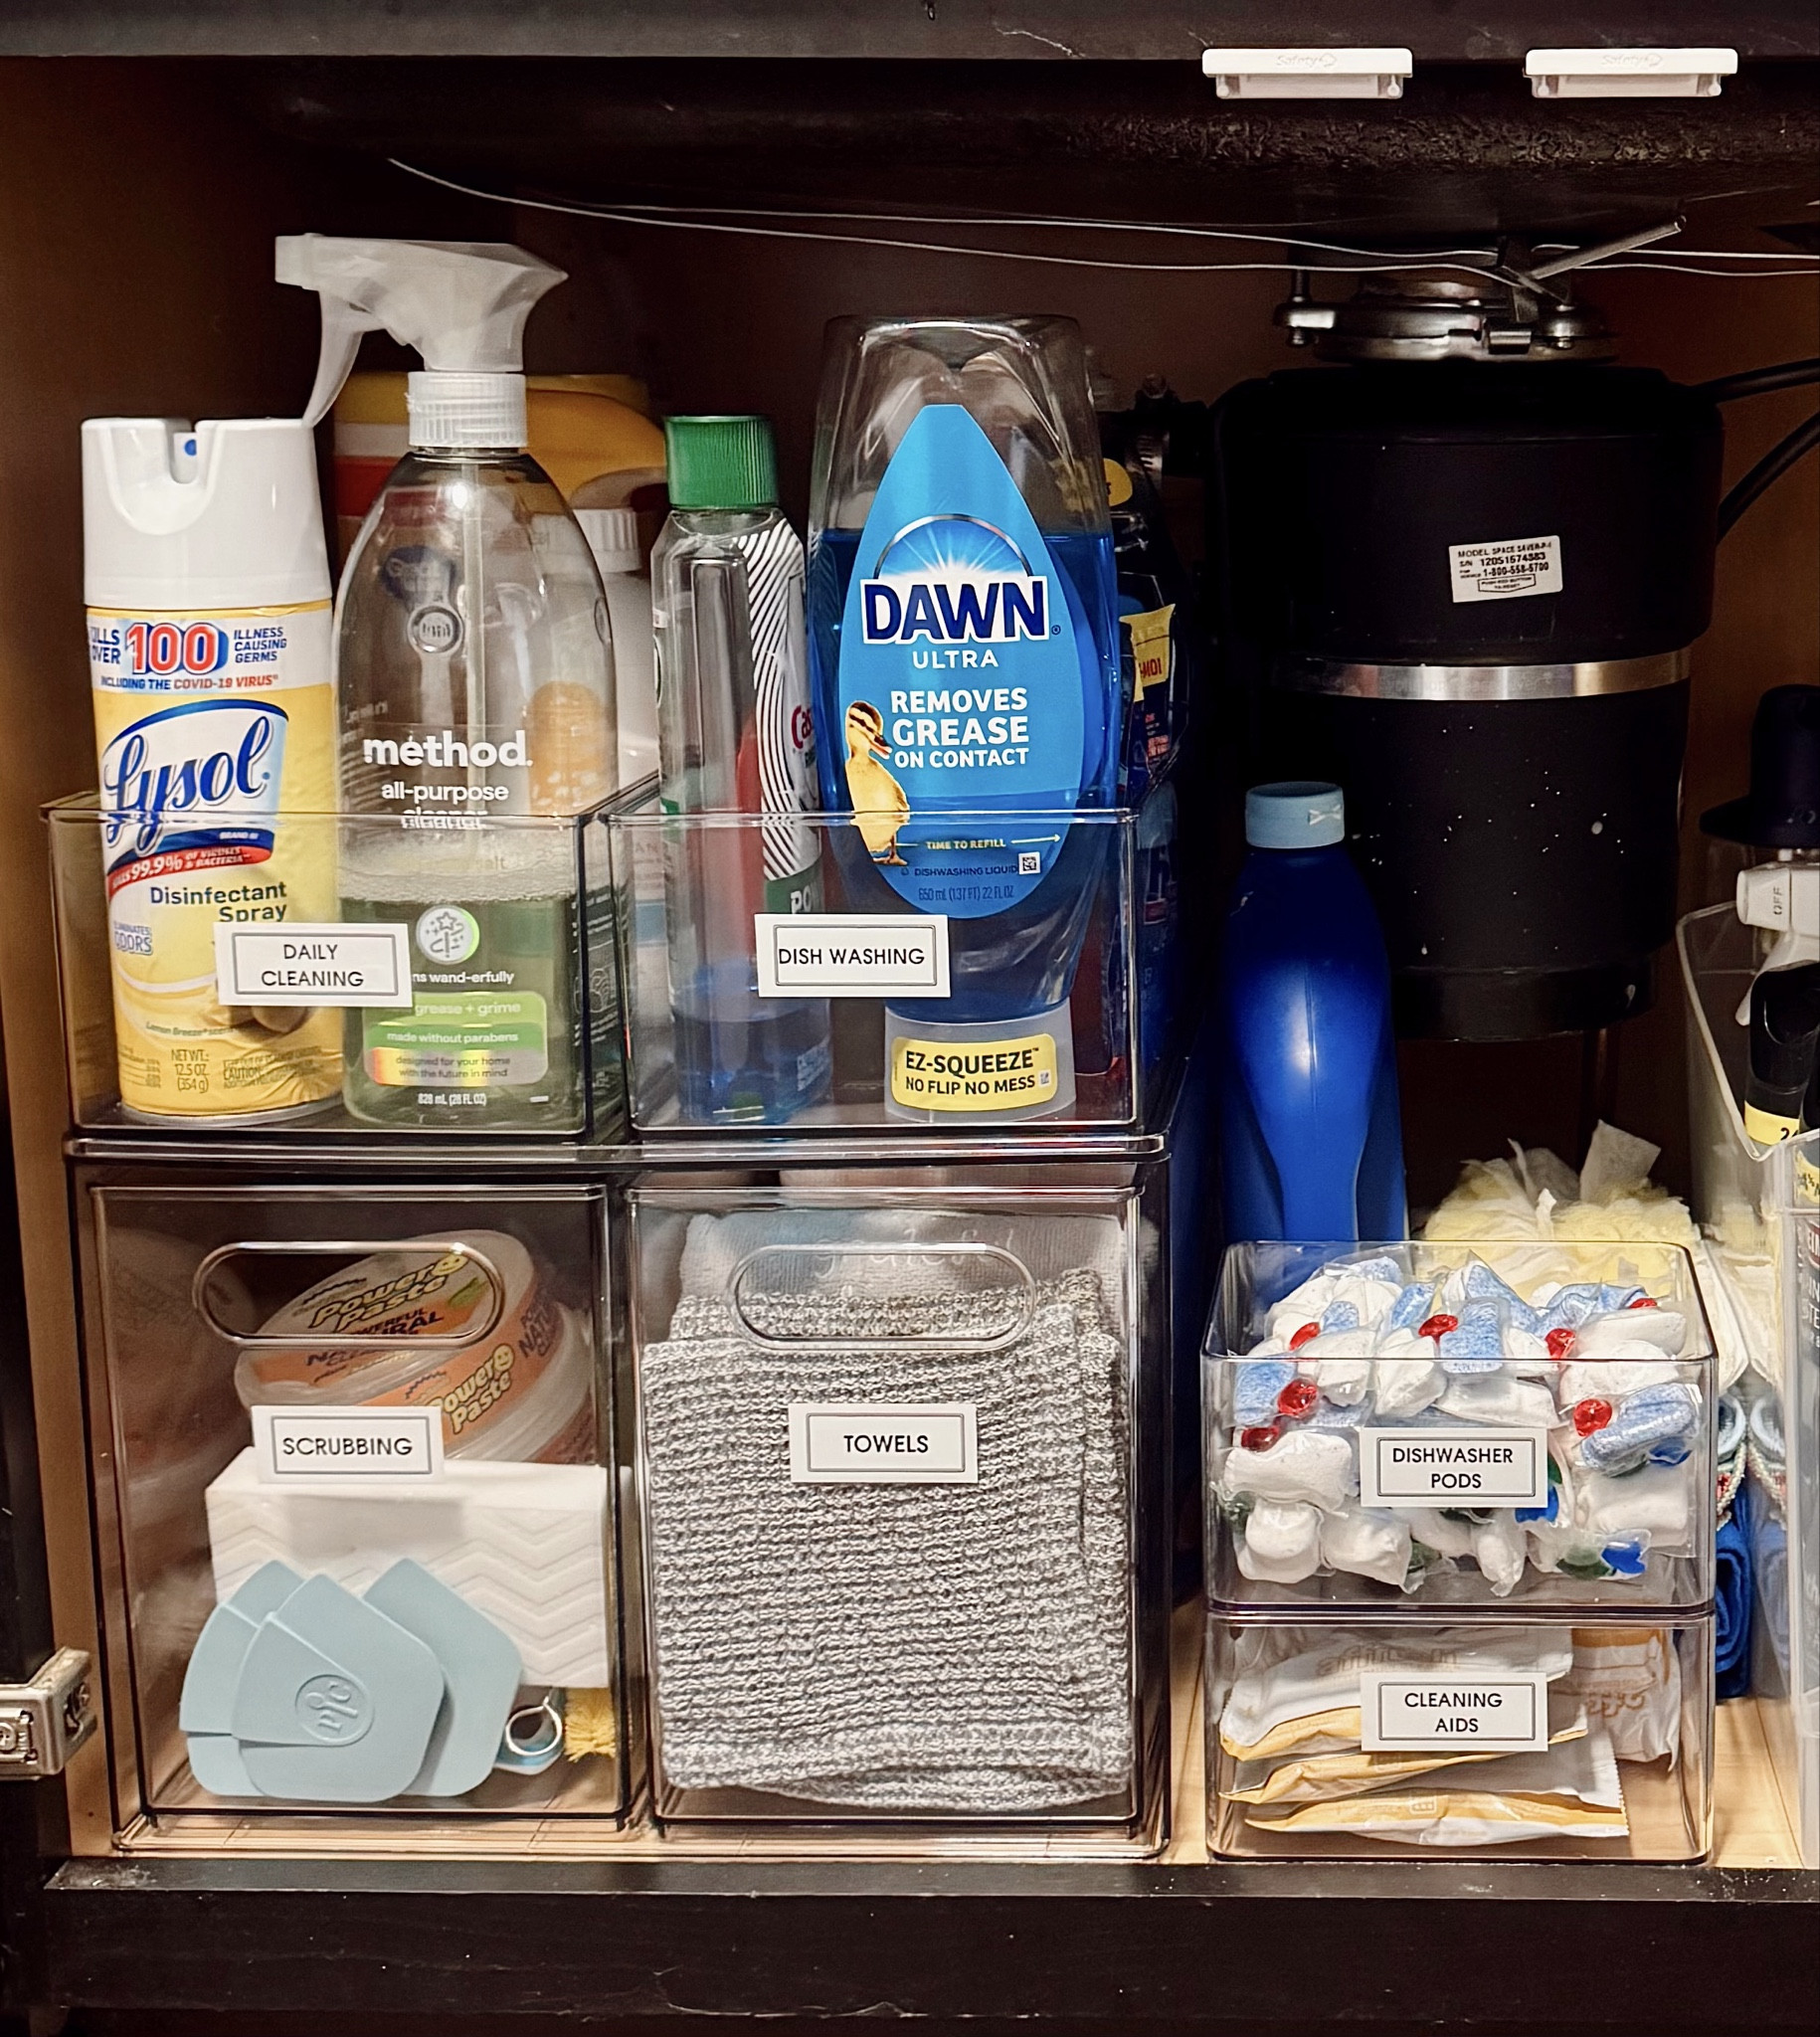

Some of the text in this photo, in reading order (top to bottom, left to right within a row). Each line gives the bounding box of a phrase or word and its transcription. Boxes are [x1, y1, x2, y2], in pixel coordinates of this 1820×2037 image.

[862, 580, 1047, 643] DAWN
[234, 627, 283, 641] ILLNESS
[125, 623, 230, 675] 100
[234, 638, 287, 652] CAUSING
[235, 650, 277, 663] GERMS
[912, 649, 999, 669] ULTRA
[148, 678, 171, 690] THE
[173, 675, 233, 689] COVID-19
[890, 687, 1028, 714] REMOVES
[892, 716, 1030, 747] GREASE
[894, 747, 1030, 769] ON CONTACT
[103, 715, 271, 855] Lysol
[381, 781, 510, 806] all-purpose
[926, 838, 1006, 849] TIME TO REFILL
[129, 854, 183, 881] 99.9%
[914, 864, 1018, 877] DISHWASHING LIQUID
[149, 880, 288, 906] Disinfectant
[982, 887, 993, 899] 22
[1773, 886, 1783, 915] OFF
[218, 903, 288, 924] Spray
[283, 945, 338, 960] DAILY
[779, 948, 925, 965] DISH WASHING
[261, 971, 365, 987] CLEANING
[429, 970, 515, 985] wand-erfully
[414, 1004, 462, 1017] grease
[476, 1002, 521, 1017] grime
[386, 1031, 519, 1044] made without parabens
[438, 1068, 468, 1079] future
[482, 1067, 508, 1077] mind
[905, 1075, 1035, 1095] NO FLIP NO MESS
[451, 1371, 512, 1434] Paste
[282, 1437, 413, 1455] SCRUBBING
[843, 1434, 929, 1453] TOWELS
[1392, 1448, 1513, 1464] DISHWASHER
[1430, 1474, 1482, 1489] PODS
[1404, 1692, 1503, 1708] CLEANING
[1435, 1717, 1479, 1733] AIDS
